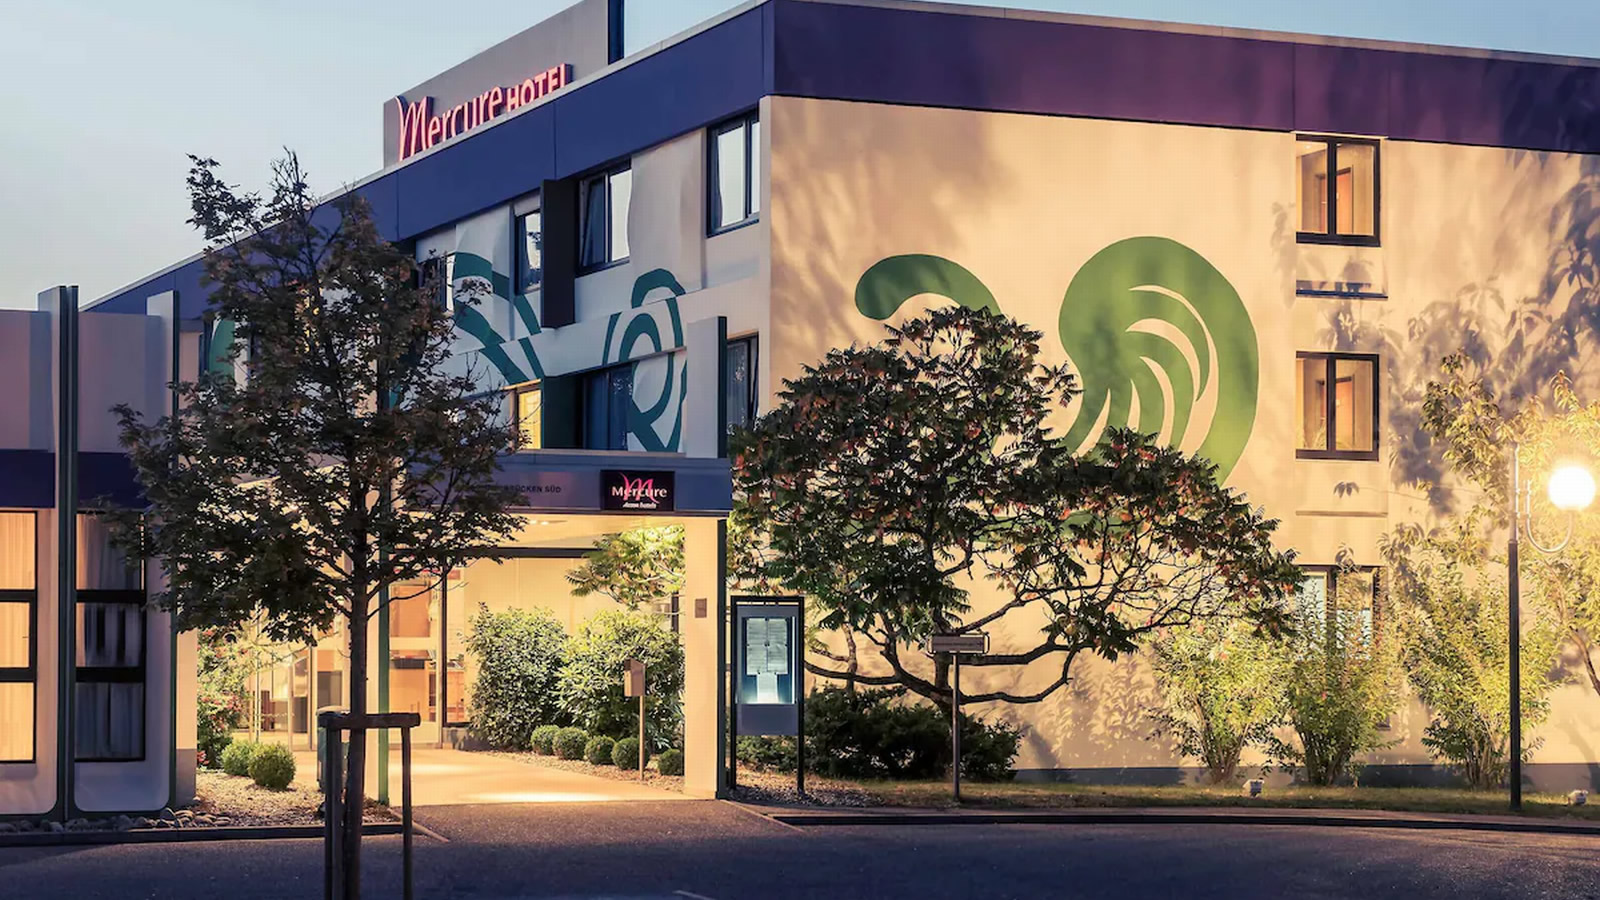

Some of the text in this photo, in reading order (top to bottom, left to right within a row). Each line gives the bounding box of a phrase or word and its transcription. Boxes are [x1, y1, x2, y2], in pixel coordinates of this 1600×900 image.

[394, 63, 569, 162] Mercure HOTEL
[611, 486, 668, 498] Mercure
